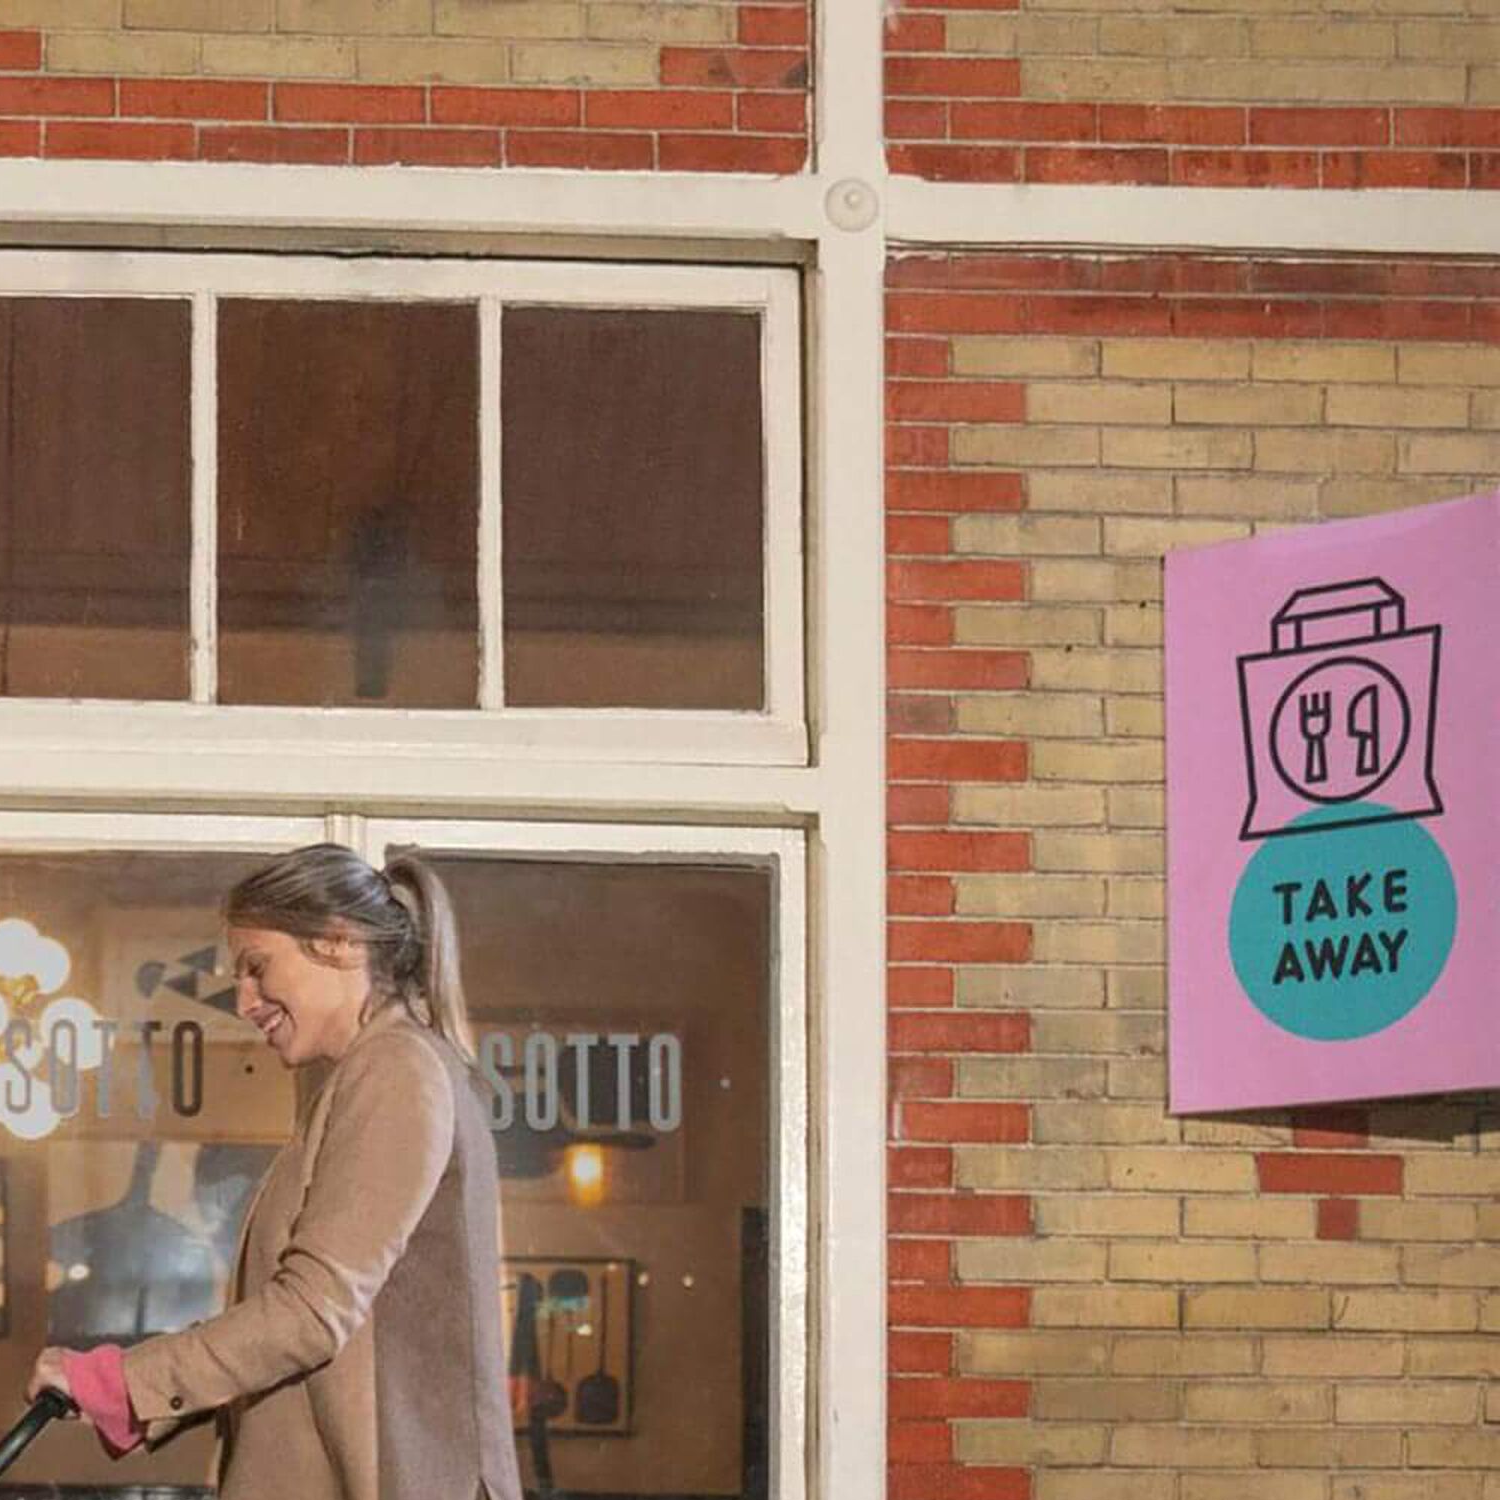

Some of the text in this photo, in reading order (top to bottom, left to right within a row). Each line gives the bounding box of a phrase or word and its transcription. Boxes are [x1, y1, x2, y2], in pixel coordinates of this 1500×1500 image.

[1272, 869, 1408, 925] TAKE
[1272, 929, 1409, 985] AWAY
[5, 1019, 205, 1118] SOTTO
[481, 1031, 682, 1132] SOTTO
